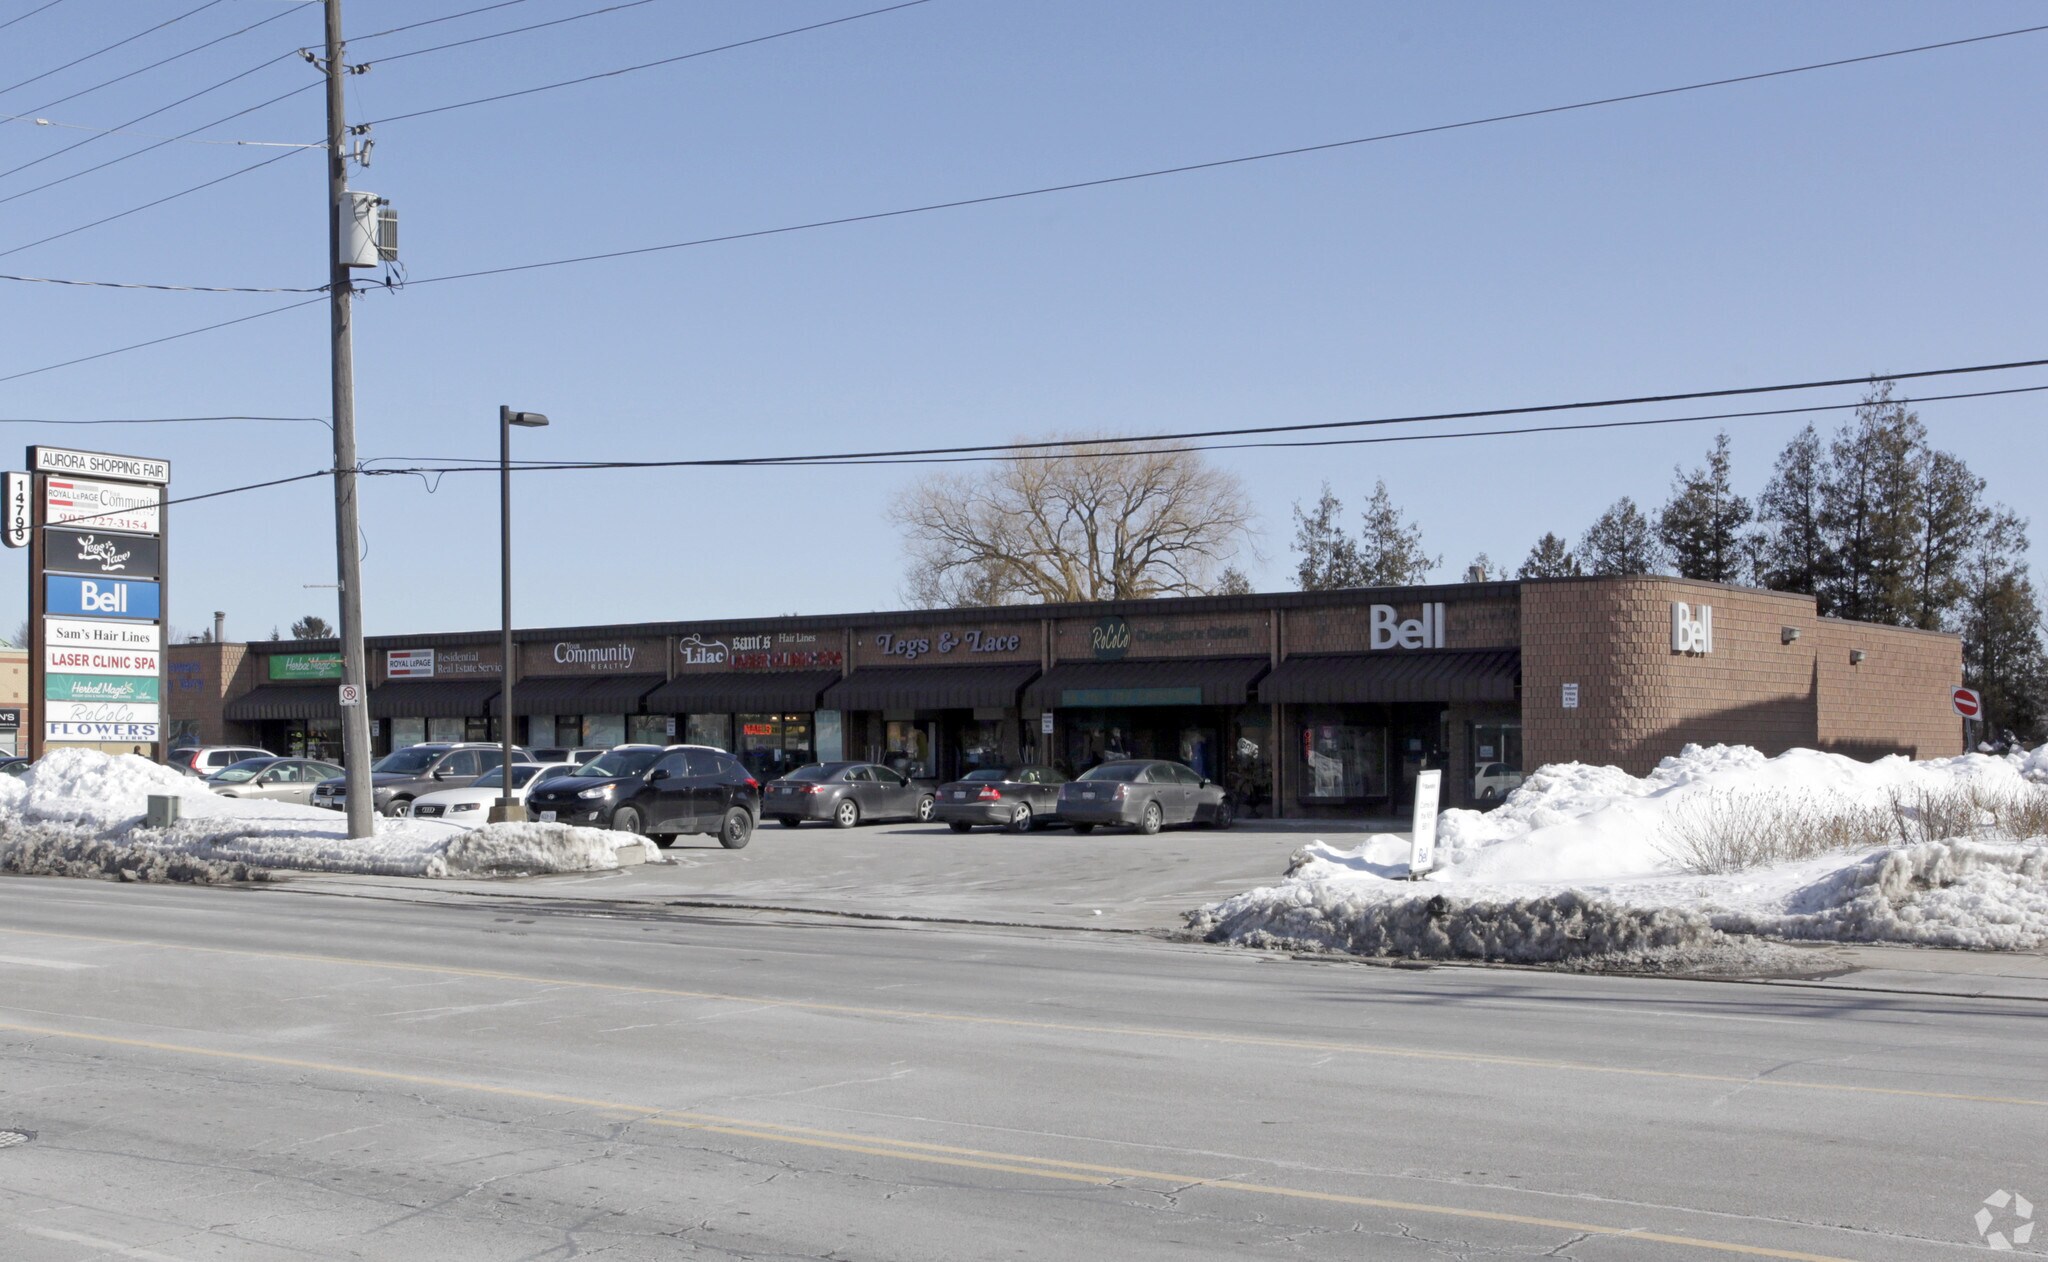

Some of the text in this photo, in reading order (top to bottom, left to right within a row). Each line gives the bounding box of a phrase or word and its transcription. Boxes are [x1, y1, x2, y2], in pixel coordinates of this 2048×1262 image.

[42, 452, 164, 478] AURORA SHOPPING FAIR
[48, 488, 71, 500] ROYAL
[100, 489, 158, 516] Community
[59, 512, 148, 530] 905-727-3154
[81, 581, 127, 613] Bell
[56, 627, 150, 643] Sam's Hair Lines
[1370, 602, 1446, 650] Bell
[1672, 602, 1713, 655] Bell
[778, 633, 795, 643] Hair
[796, 632, 817, 643] Lines
[876, 630, 1020, 660] Legs & Lace
[1092, 623, 1130, 650] RoCoCo
[52, 653, 155, 670] LASER CLINIC SPA
[286, 656, 310, 671] Herbal
[389, 659, 409, 668] ROYAL
[437, 651, 479, 662] Residential
[553, 641, 635, 669] Community
[685, 646, 724, 664] Lilac
[437, 664, 454, 674] Real
[455, 663, 477, 673] Estate
[591, 662, 624, 670] REALTY
[71, 681, 102, 693] Herbal
[102, 682, 128, 699] Magic
[70, 703, 134, 721] RoCoCo
[50, 723, 156, 735] FLOWERS
